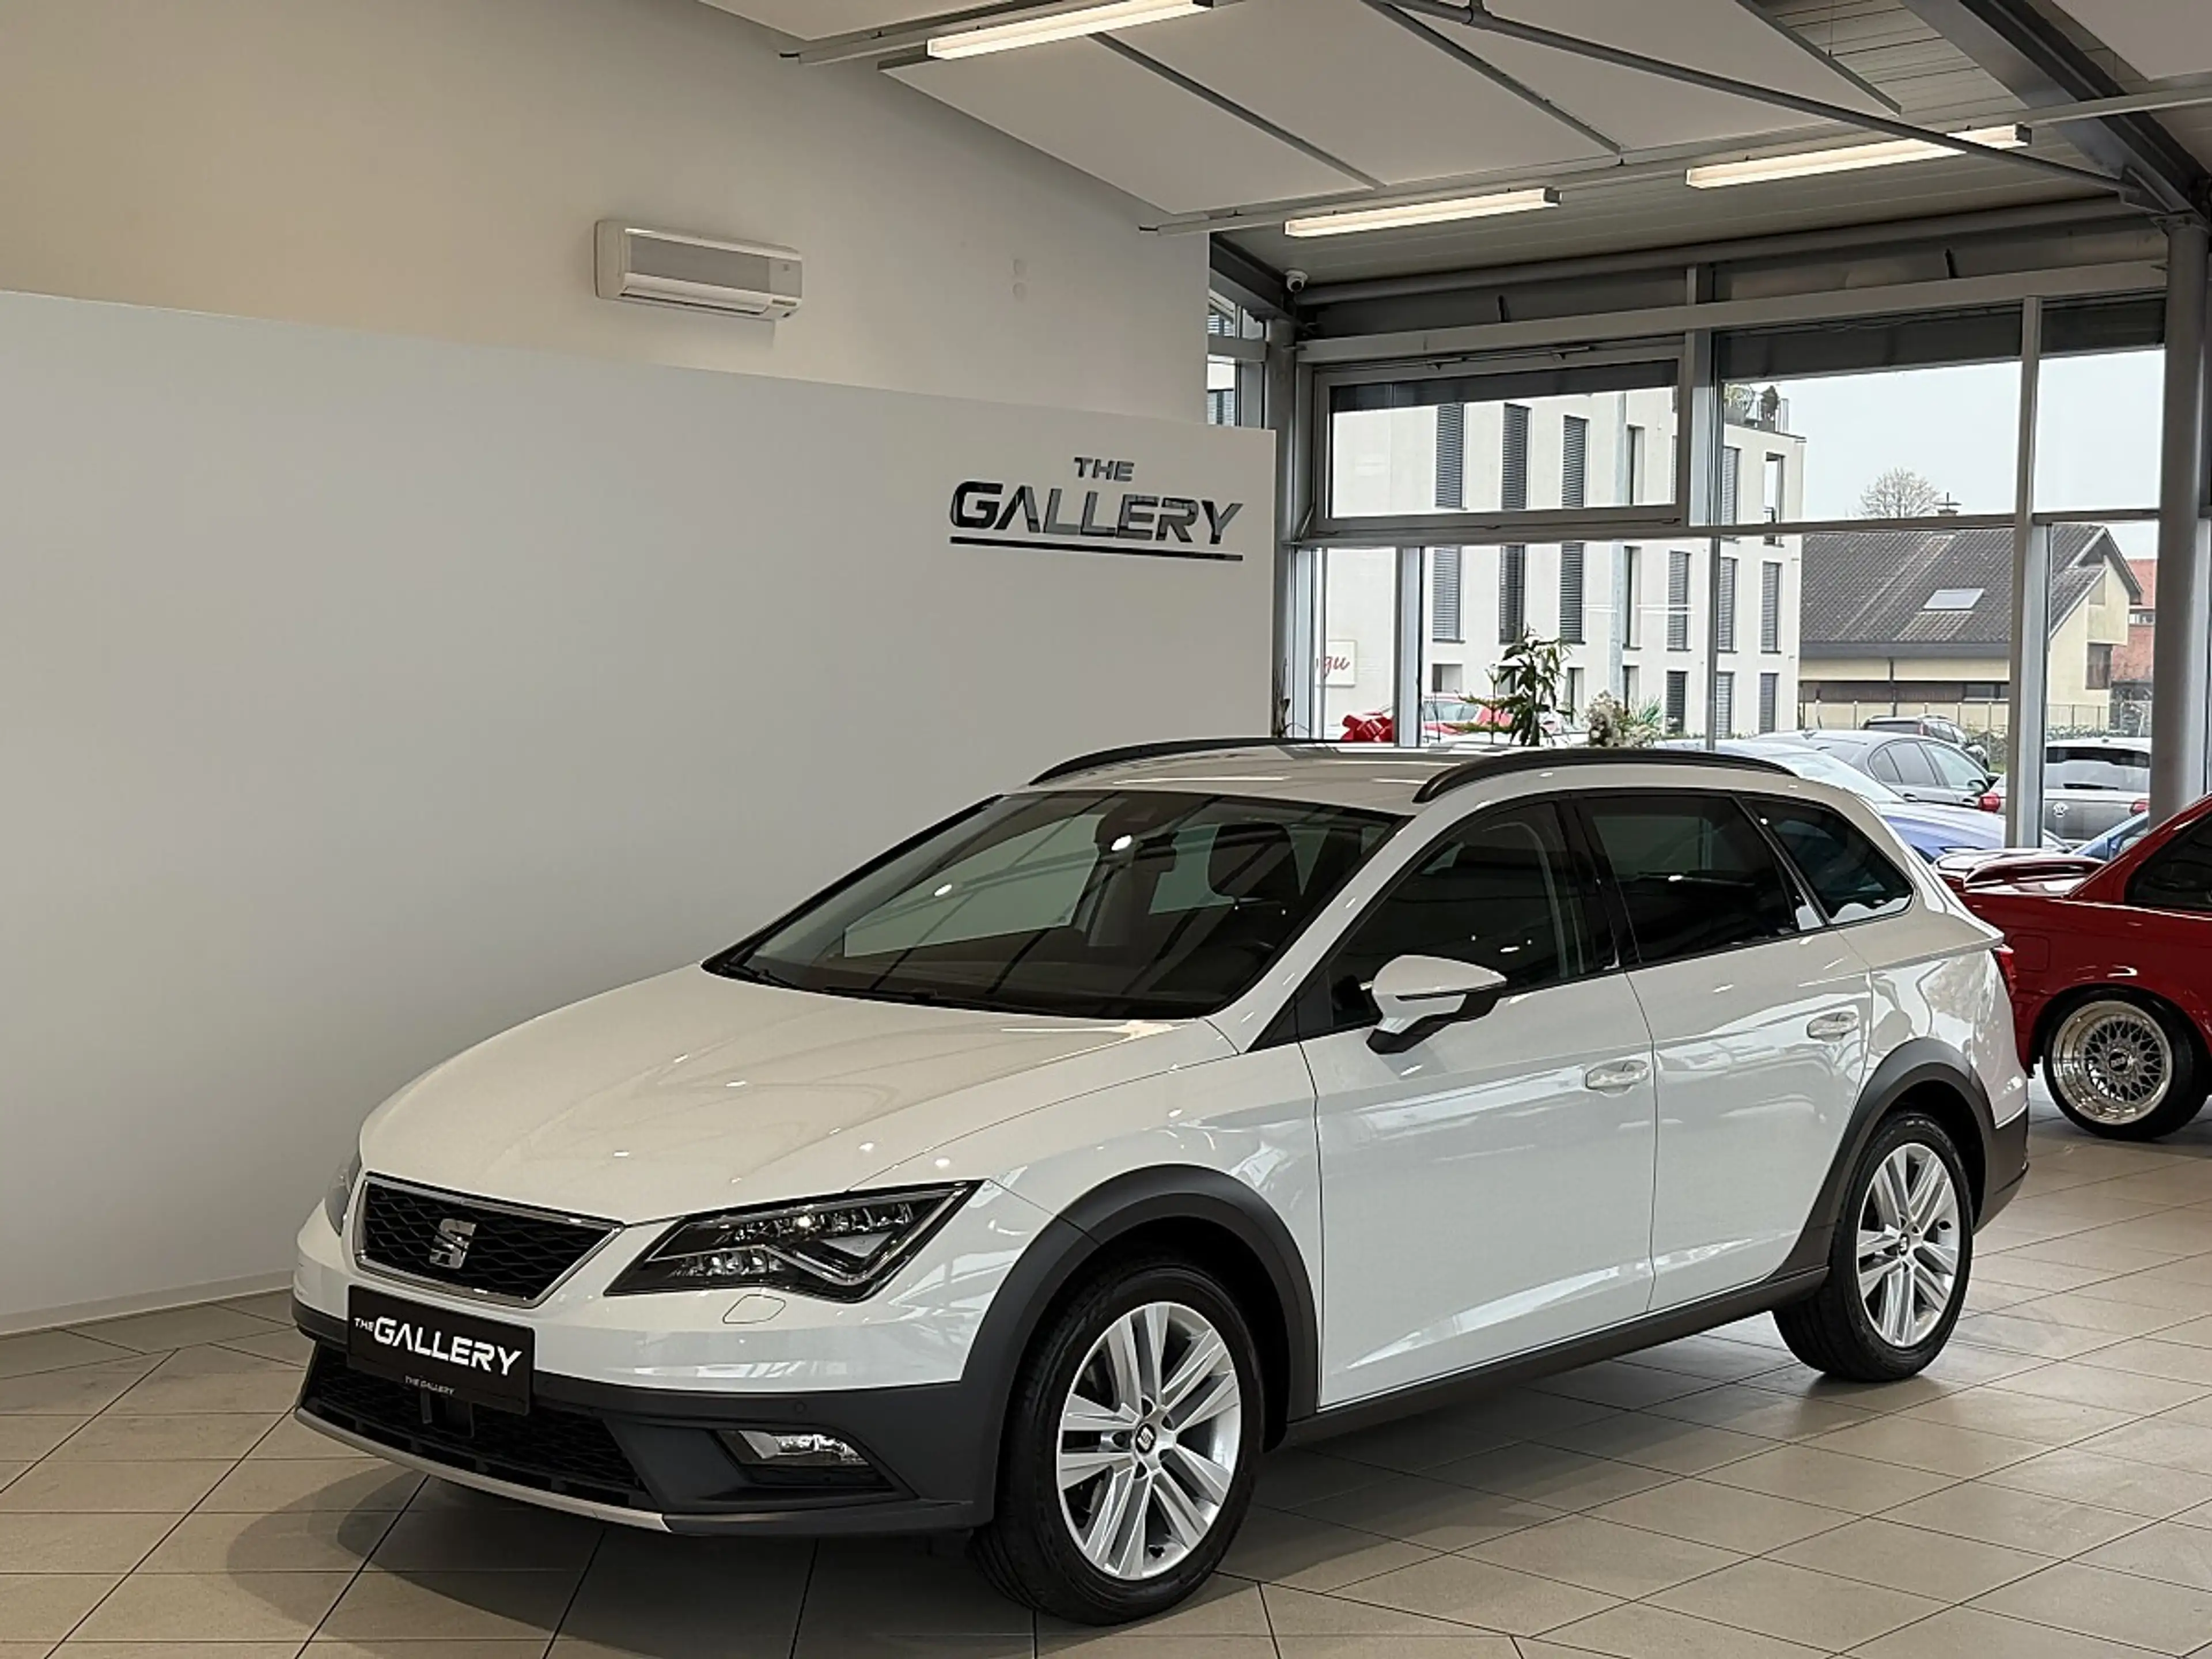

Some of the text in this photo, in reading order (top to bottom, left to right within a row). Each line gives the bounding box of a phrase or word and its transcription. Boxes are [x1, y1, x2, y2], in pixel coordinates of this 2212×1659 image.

[1074, 457, 1134, 482] THE
[949, 480, 1243, 544] GALLERY
[354, 1316, 522, 1376] THE GALLERY
